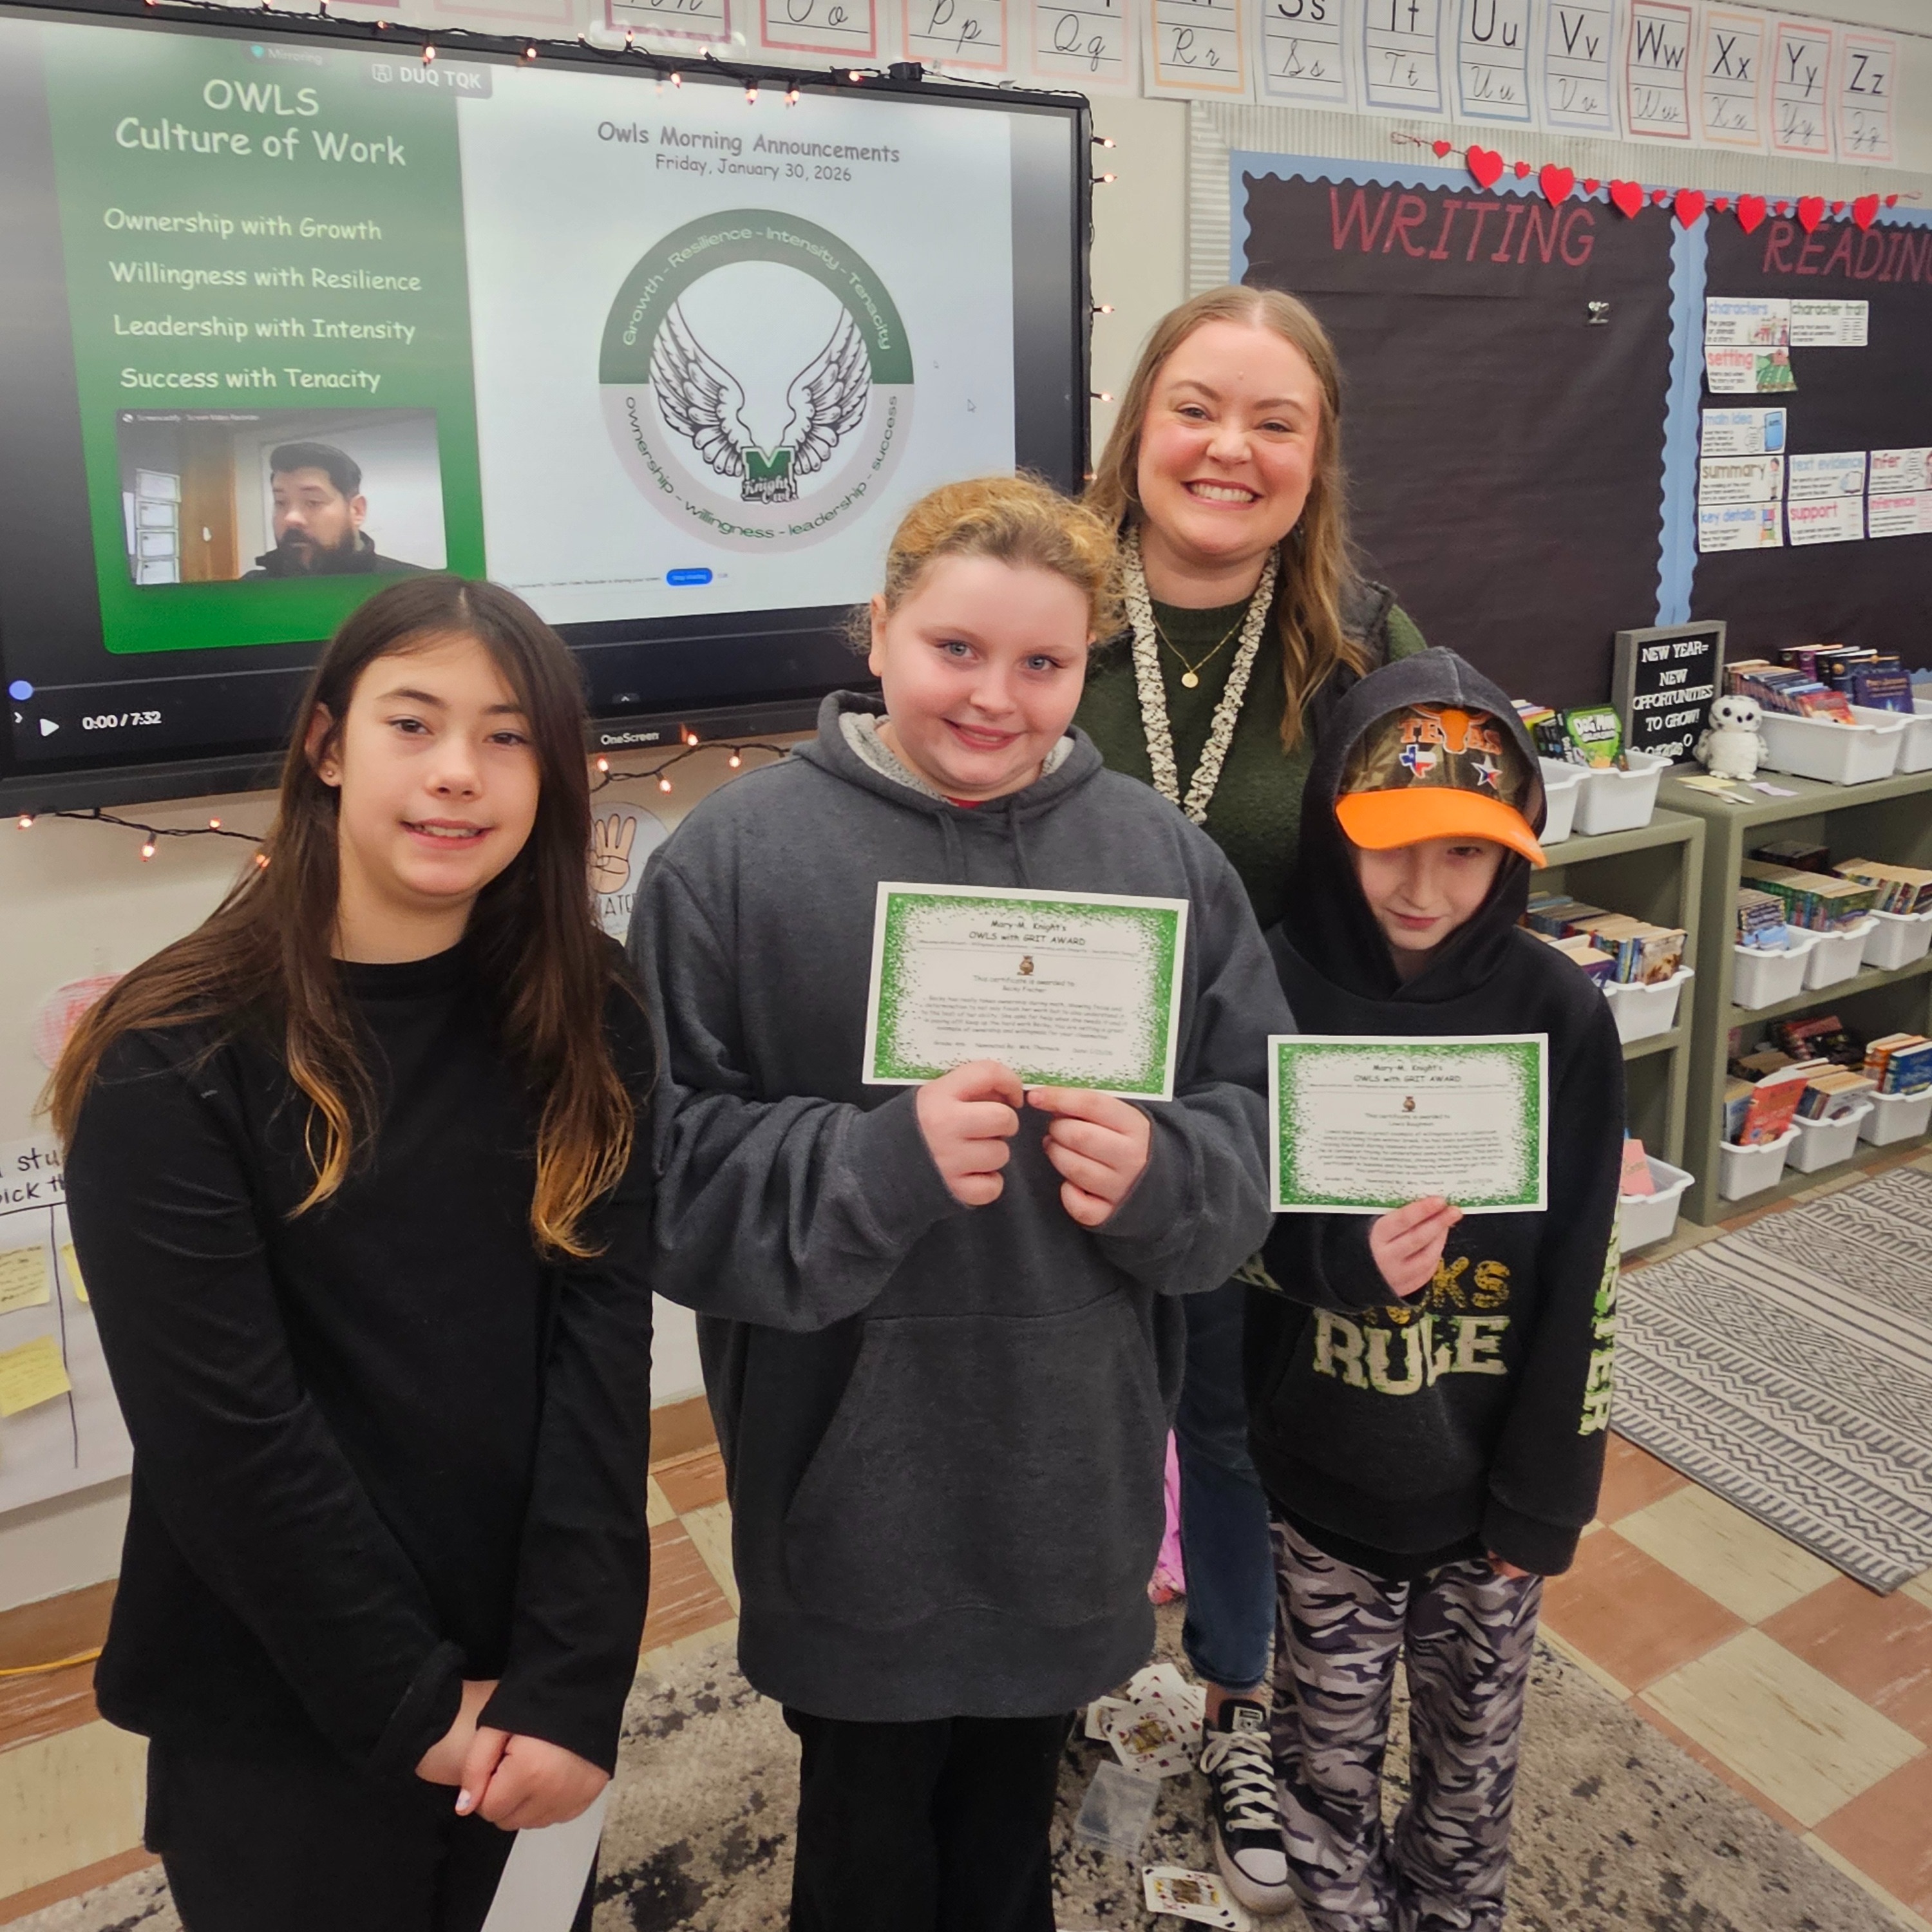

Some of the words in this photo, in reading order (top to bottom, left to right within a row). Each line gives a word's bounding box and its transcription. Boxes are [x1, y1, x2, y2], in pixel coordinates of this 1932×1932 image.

[399, 67, 439, 86] DUQ
[444, 70, 481, 89] TQK
[203, 79, 320, 116] OWLS
[115, 117, 252, 155] Culture
[262, 128, 300, 160] of
[312, 131, 406, 166] Work
[598, 121, 649, 145] Owls
[659, 127, 743, 155] Morning
[753, 133, 900, 164] Announcements
[656, 154, 713, 176] Friday,
[717, 157, 780, 181] January
[784, 163, 810, 182] 30,
[814, 164, 853, 182] 2026
[104, 208, 234, 238] Ownership
[242, 216, 292, 236] with
[299, 218, 382, 240] Growth
[1328, 187, 1595, 266] WRITING
[1763, 219, 1932, 284] READIN
[109, 261, 247, 290] Willingness
[254, 267, 305, 287] with
[312, 268, 422, 291] Resilience
[623, 275, 663, 346] Growth
[668, 226, 752, 269] Resilience
[766, 226, 840, 270] Intensity
[849, 272, 891, 350] Tenacity
[1709, 301, 1769, 316] characters
[1792, 302, 1842, 316] character
[114, 315, 248, 342] Leadership
[256, 319, 305, 338] with
[313, 319, 415, 345] Intensity
[1708, 349, 1754, 370] setting
[120, 368, 218, 388] Success
[226, 368, 277, 388] with
[283, 367, 381, 393] Tenacity
[625, 396, 674, 494] ownership
[685, 498, 775, 539] willingness
[788, 481, 867, 535] leadership
[871, 395, 897, 471] success
[1703, 463, 1766, 480] summary
[1701, 510, 1719, 526] key
[1790, 501, 1838, 524] support
[1642, 645, 1671, 662] NEW
[1659, 668, 1688, 687] NEW
[1633, 685, 1714, 710] OPPORTUNITIES
[82, 714, 118, 730] 0:00
[131, 710, 162, 726] 7:32
[1645, 716, 1663, 732] TO
[1665, 708, 1701, 728] GROW!
[600, 732, 660, 746] OneScreen
[969, 931, 997, 940] OWLS
[1023, 934, 1046, 943] GRIT
[1051, 937, 1086, 945] AWARD
[1312, 1306, 1511, 1396] RULE
